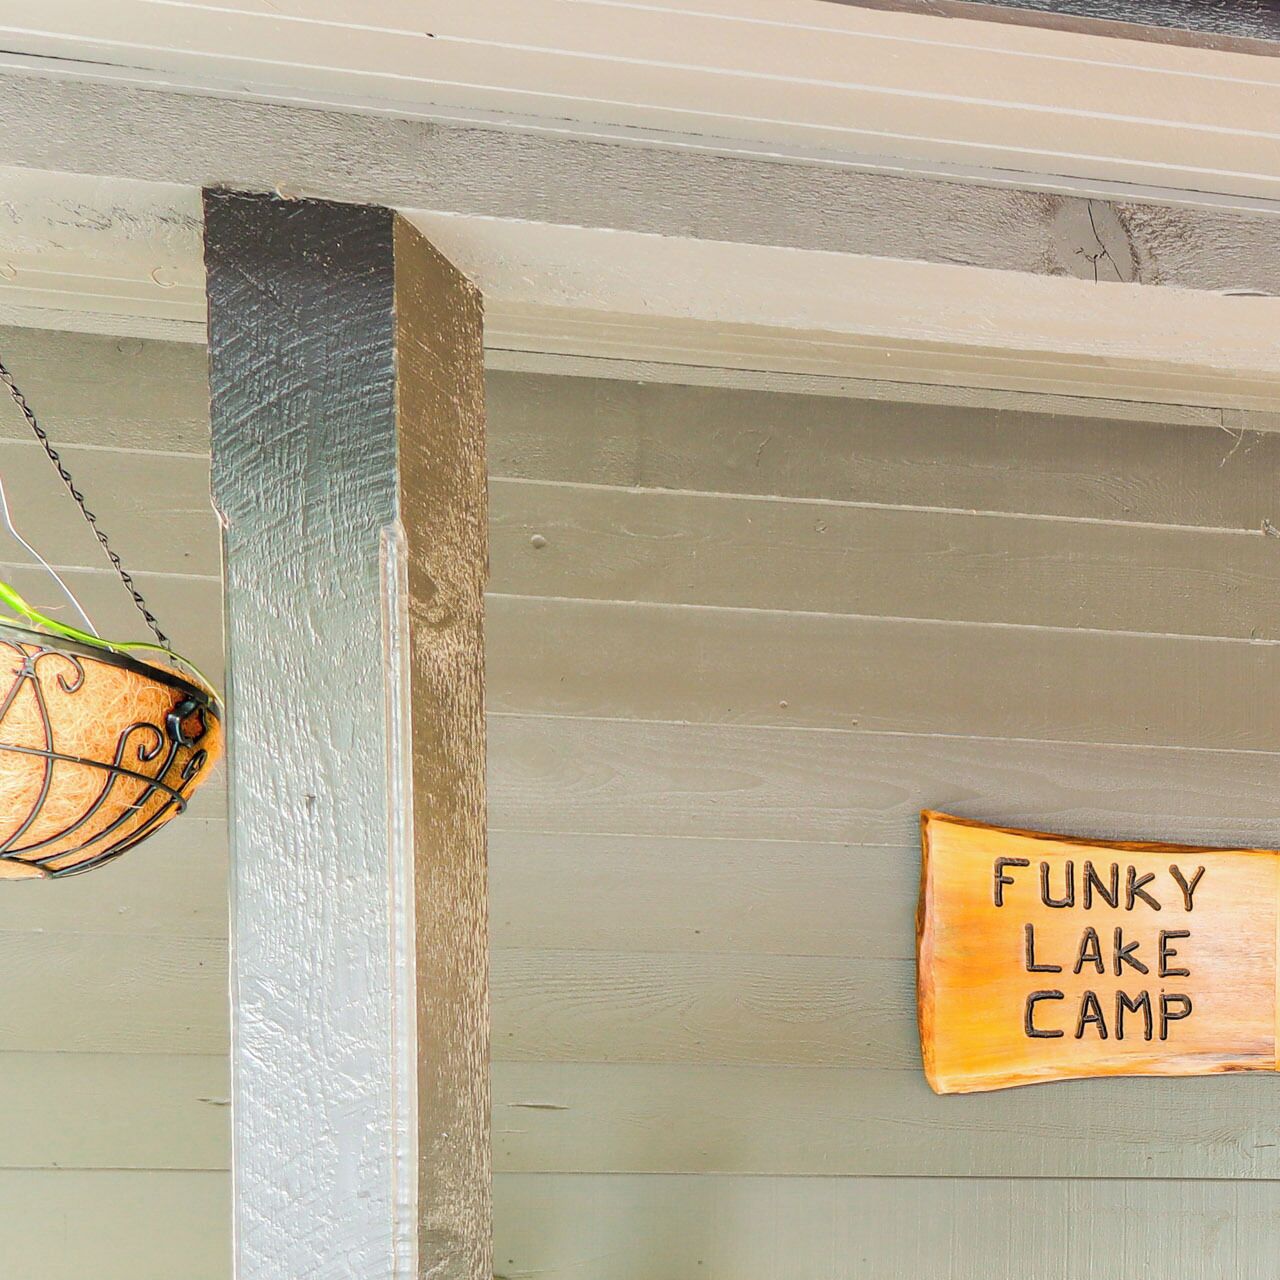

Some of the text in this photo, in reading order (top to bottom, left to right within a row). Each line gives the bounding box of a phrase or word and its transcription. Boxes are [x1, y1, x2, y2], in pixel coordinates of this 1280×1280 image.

[994, 857, 1205, 911] FUNKY
[1025, 923, 1190, 977] LAKE
[1025, 989, 1192, 1040] CAMP
